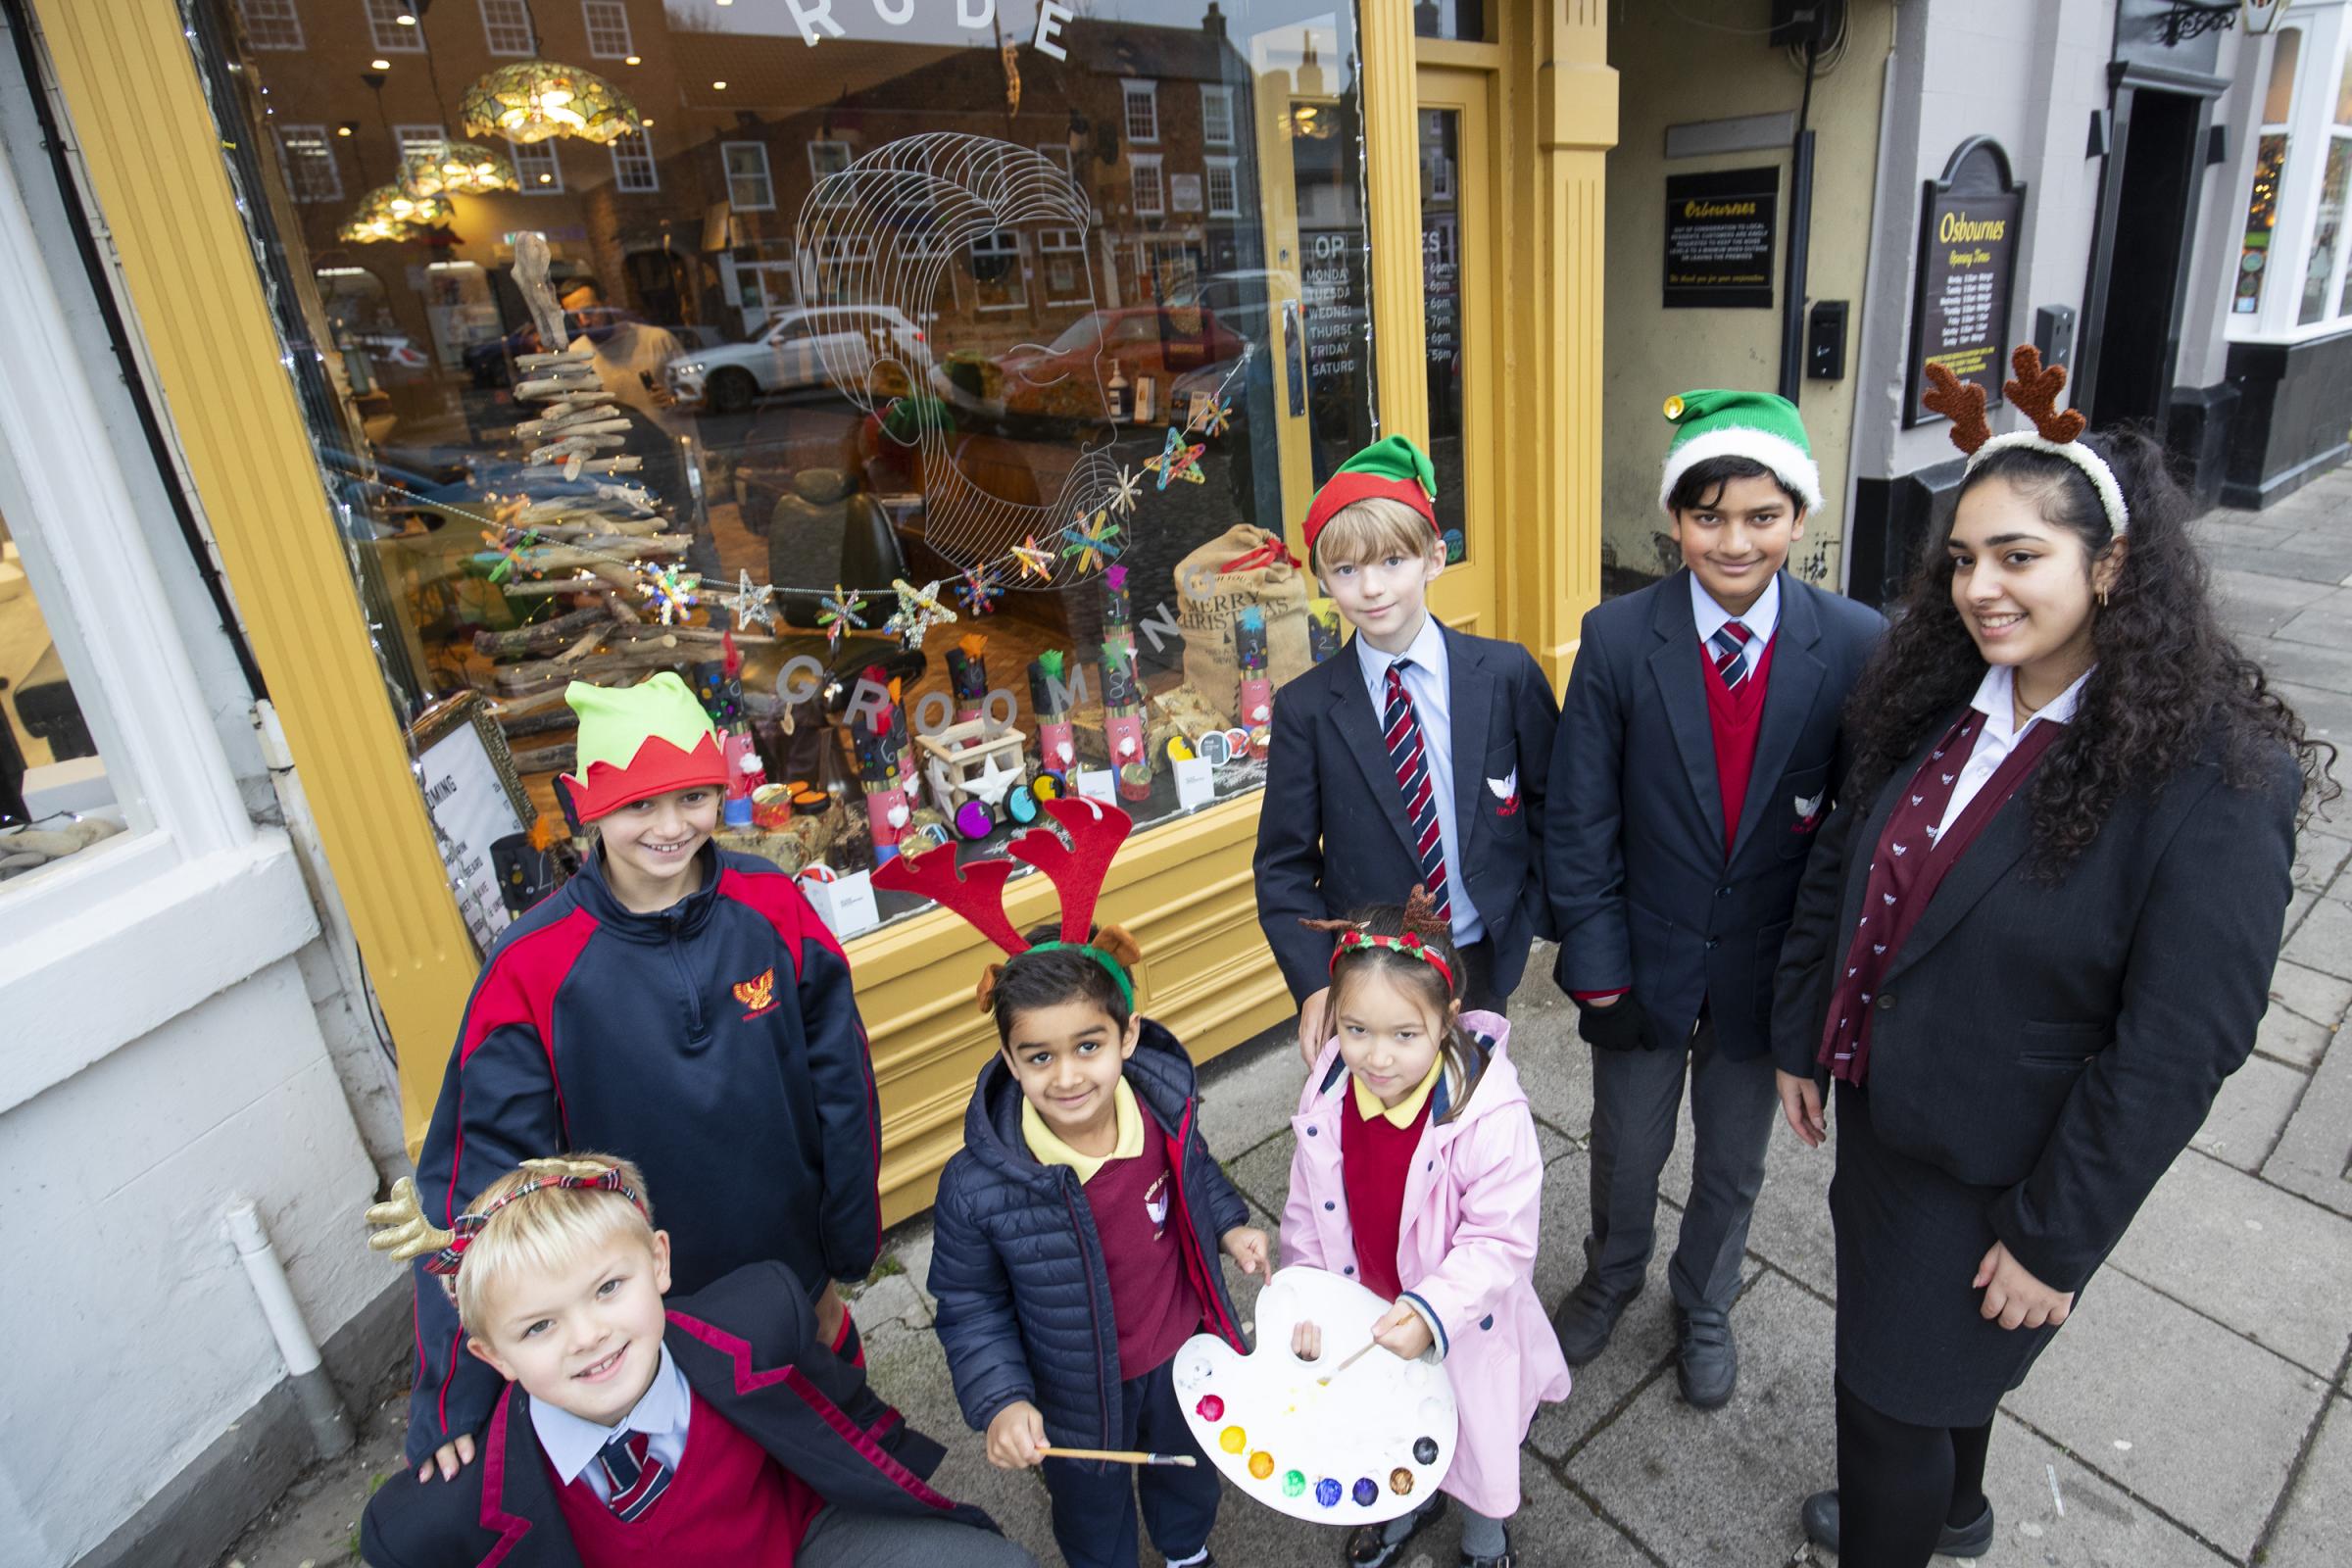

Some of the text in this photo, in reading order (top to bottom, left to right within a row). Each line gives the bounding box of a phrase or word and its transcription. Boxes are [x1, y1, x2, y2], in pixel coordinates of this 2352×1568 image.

[1939, 211, 2005, 244] Osbournes
[1306, 268, 1348, 283] MONDA
[1308, 297, 1450, 320] WEDNE 6pm
[1431, 314, 1450, 329] 7pm
[1310, 331, 1451, 359] FRIDAY 6pm
[1432, 348, 1452, 362] 5pm
[1184, 591, 1260, 613] MERRY
[775, 563, 1216, 736] GROOMING
[1108, 671, 1125, 699] 8
[880, 737, 896, 763] 6
